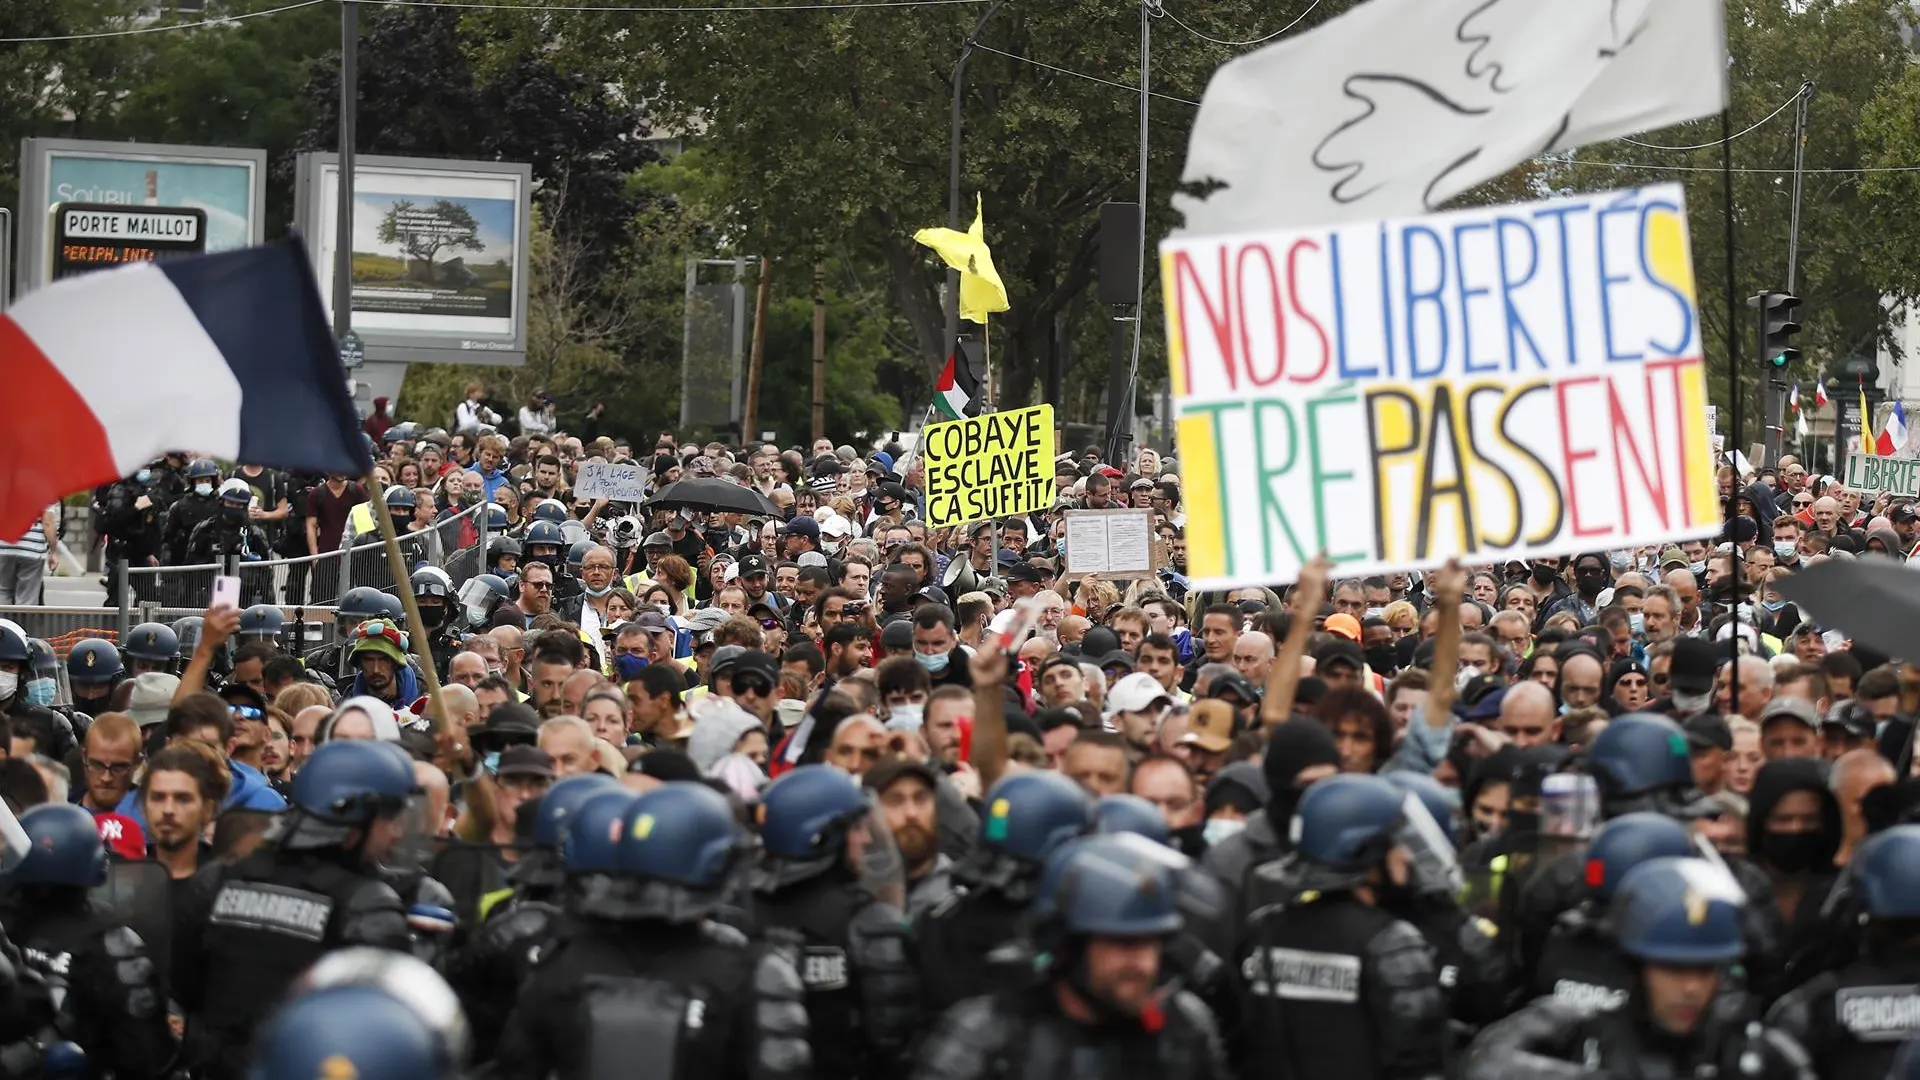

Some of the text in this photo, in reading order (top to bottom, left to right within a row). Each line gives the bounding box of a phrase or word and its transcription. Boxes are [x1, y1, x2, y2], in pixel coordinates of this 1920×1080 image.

[69, 215, 193, 236] PORTE MAILLOT
[1173, 188, 1697, 395] NOS LIBERTÉS
[926, 410, 1041, 462] COBAYE
[583, 481, 597, 494] LA
[928, 449, 1039, 496] ESCLAVE
[1182, 357, 1703, 577] TRÉPASSENT
[928, 494, 963, 528] ÇA
[214, 886, 331, 933] GENDARMERIE
